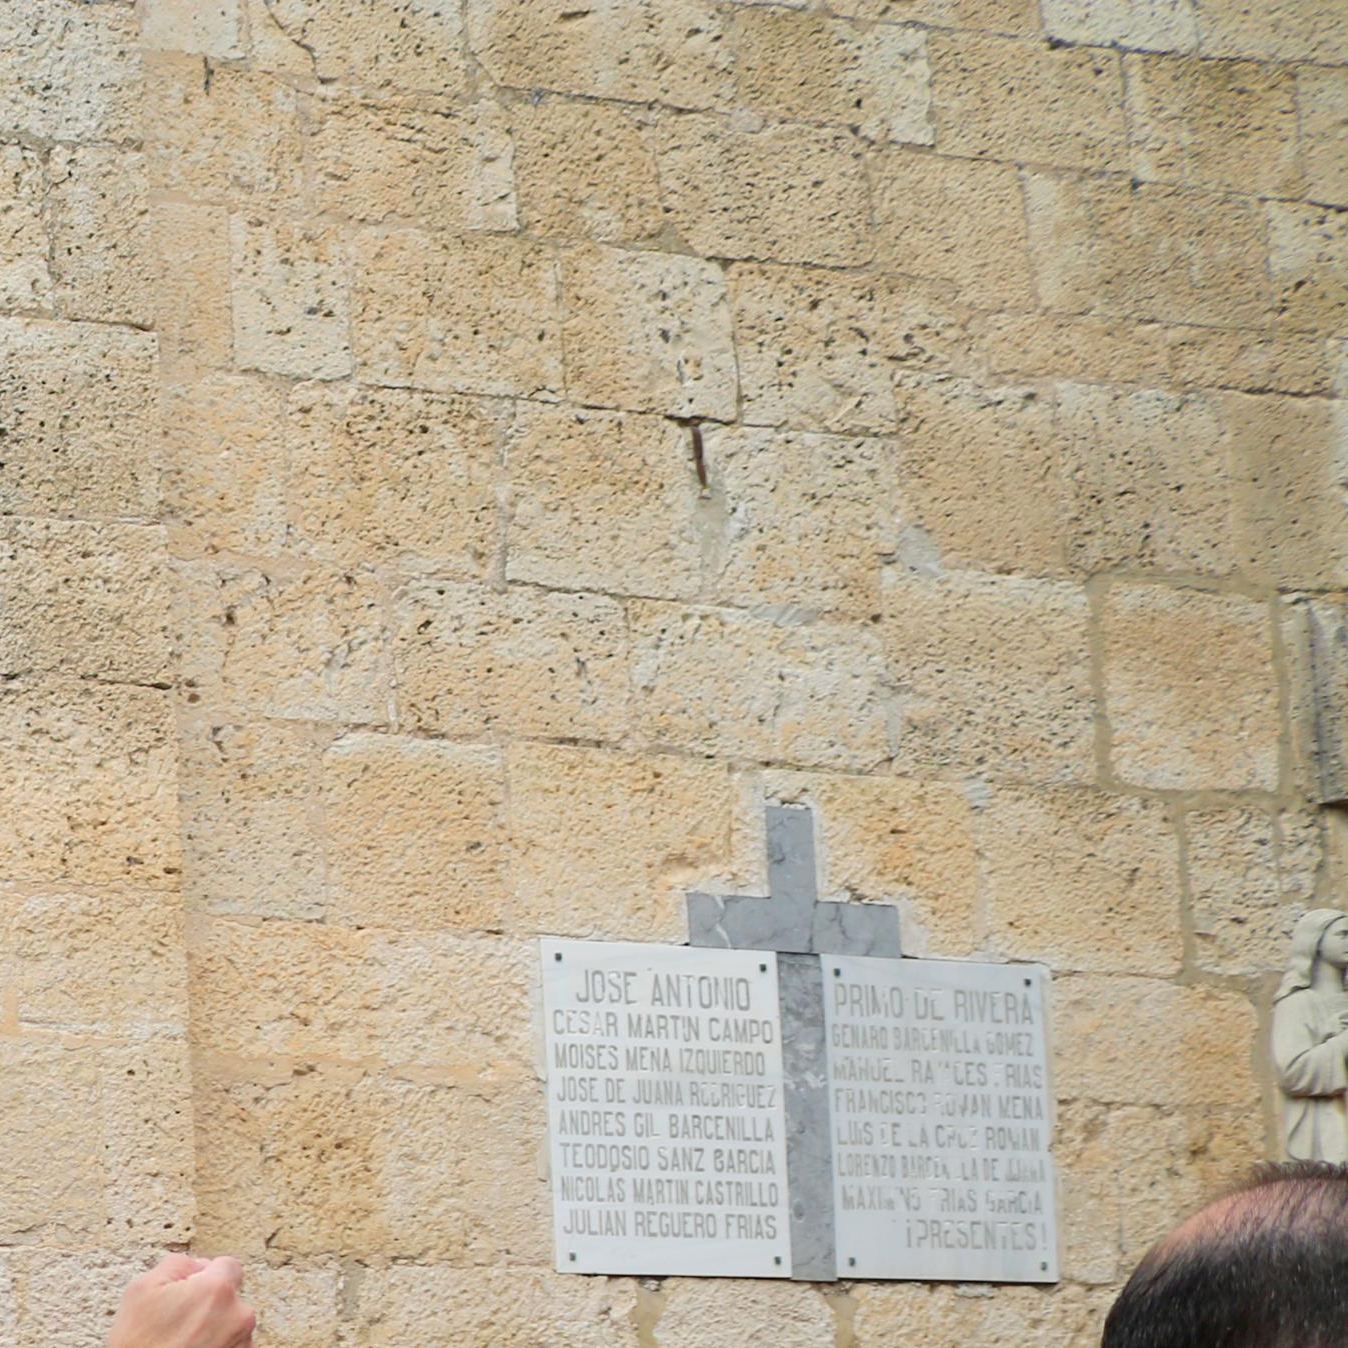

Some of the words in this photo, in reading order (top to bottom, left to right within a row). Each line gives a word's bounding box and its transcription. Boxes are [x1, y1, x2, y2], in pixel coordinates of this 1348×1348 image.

[576, 969, 637, 1005] JOSE
[650, 973, 752, 1011] ANTONIO
[834, 983, 904, 1019] PRIMO
[914, 988, 945, 1020] DE
[954, 989, 1034, 1025] RIVERA
[553, 1009, 619, 1037] CESAR
[627, 1012, 700, 1041] MARTIN
[708, 1017, 774, 1044] CAMPO
[831, 1023, 889, 1049] GENARO
[893, 1026, 981, 1053] BARCENILLA
[986, 1031, 1034, 1057] GOMEZ
[554, 1043, 619, 1070] MOISES
[625, 1047, 673, 1073] MENA
[679, 1048, 766, 1076] IZQUIERDO
[833, 1055, 905, 1083] MANUEL
[557, 1076, 598, 1103] JOSE
[605, 1078, 626, 1104] DE
[632, 1079, 684, 1106] JUANA
[689, 1081, 777, 1109] RODRIGUEZ
[835, 1088, 927, 1115] FRANCISCO
[998, 1094, 1043, 1120] MENA
[559, 1110, 626, 1137] ANDRES
[633, 1112, 661, 1138] GIL
[669, 1113, 776, 1141] BARCENILLA
[836, 1121, 874, 1146] LUIS
[559, 1142, 650, 1170] TEODOSIO
[657, 1147, 705, 1172] SANZ
[713, 1148, 776, 1174] GARCIA
[838, 1154, 896, 1179] LORENZO
[901, 1156, 979, 1181] BARCENLLA
[983, 1157, 1000, 1181] DE
[560, 1176, 626, 1202] NICOLAS
[633, 1178, 689, 1204] MARTIN
[695, 1180, 779, 1207] CASTRILLO
[986, 1190, 1044, 1215] GARCIA
[563, 1209, 627, 1236] JULIAN
[634, 1211, 717, 1238] REGUERO
[725, 1213, 777, 1239] FRIAS
